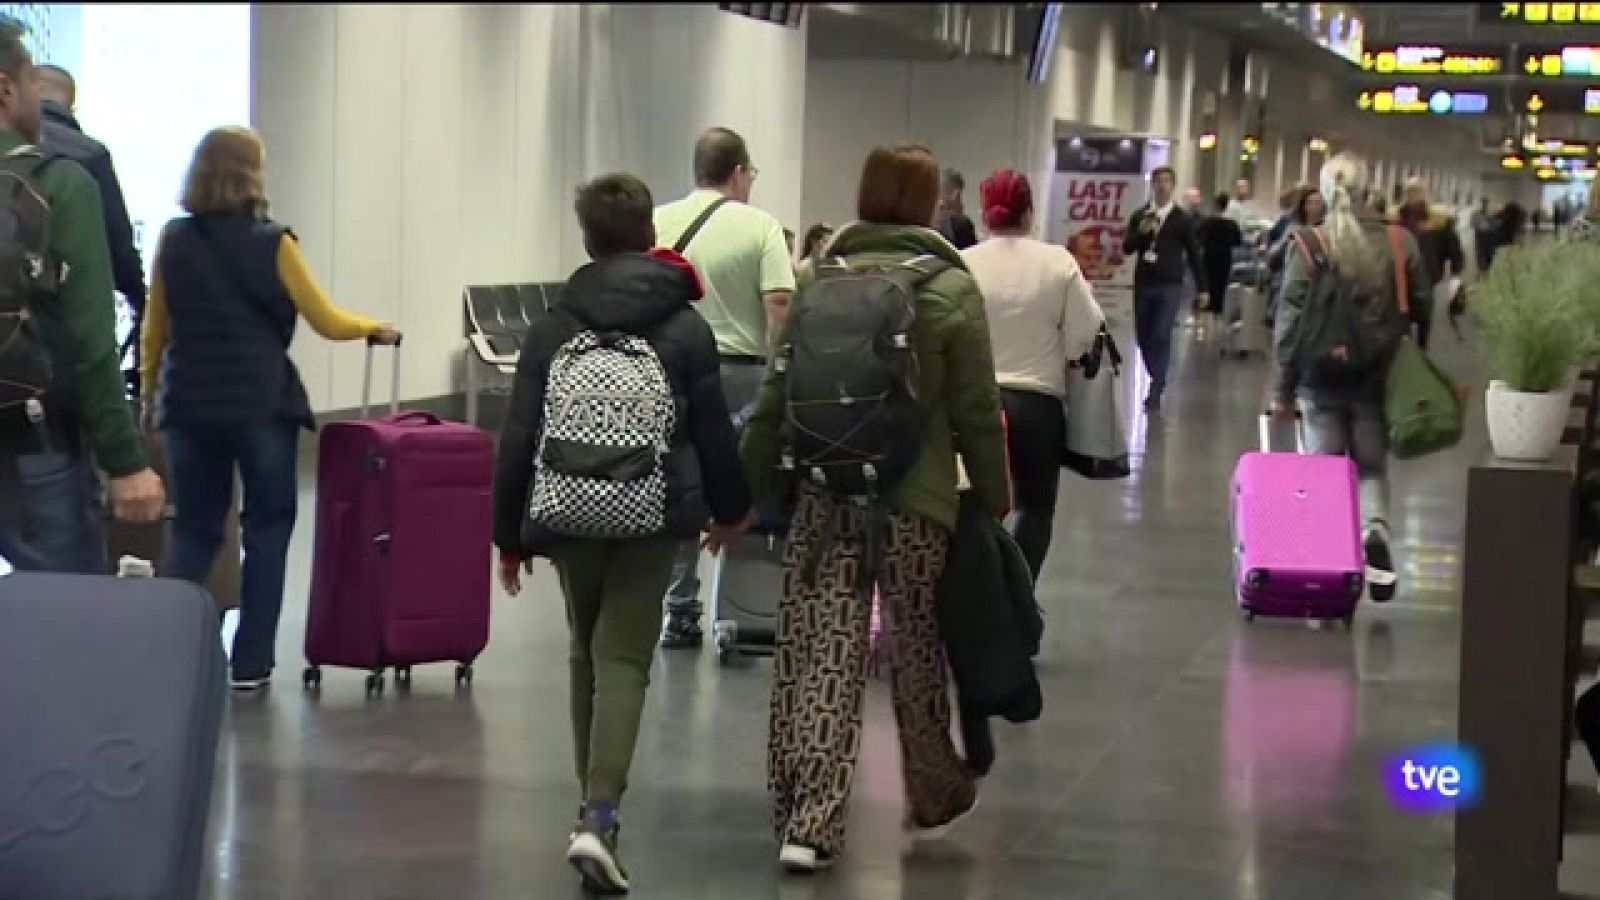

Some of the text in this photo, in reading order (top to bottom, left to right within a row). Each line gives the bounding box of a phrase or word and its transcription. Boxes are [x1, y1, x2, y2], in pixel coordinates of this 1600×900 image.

[1068, 179, 1129, 200] LAST
[1069, 202, 1125, 221] CALL
[548, 394, 658, 432] VANS
